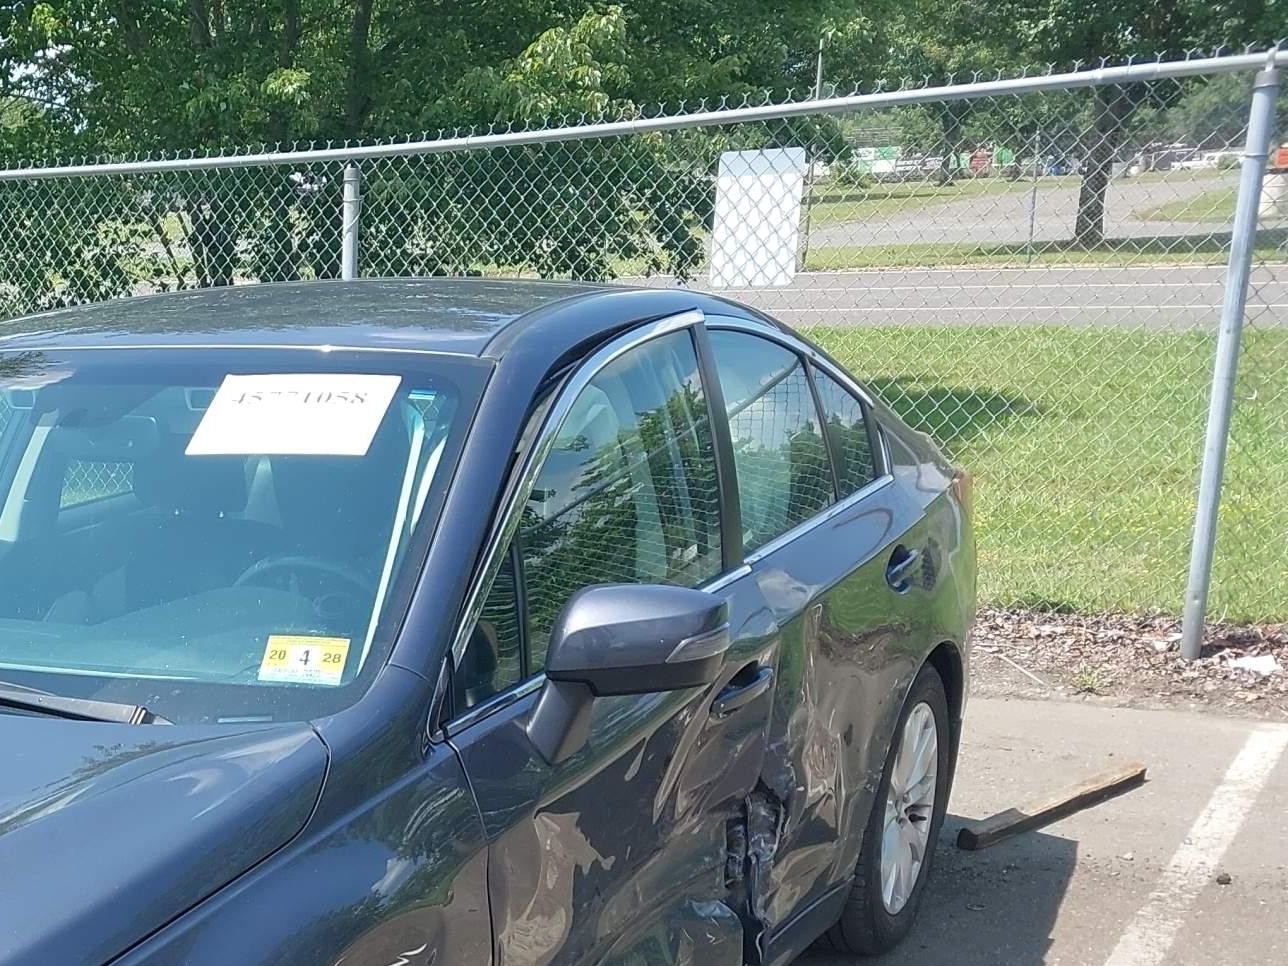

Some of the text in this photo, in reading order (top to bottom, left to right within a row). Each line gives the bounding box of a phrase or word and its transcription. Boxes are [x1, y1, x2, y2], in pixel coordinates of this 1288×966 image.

[269, 649, 342, 666] 20 4 28
